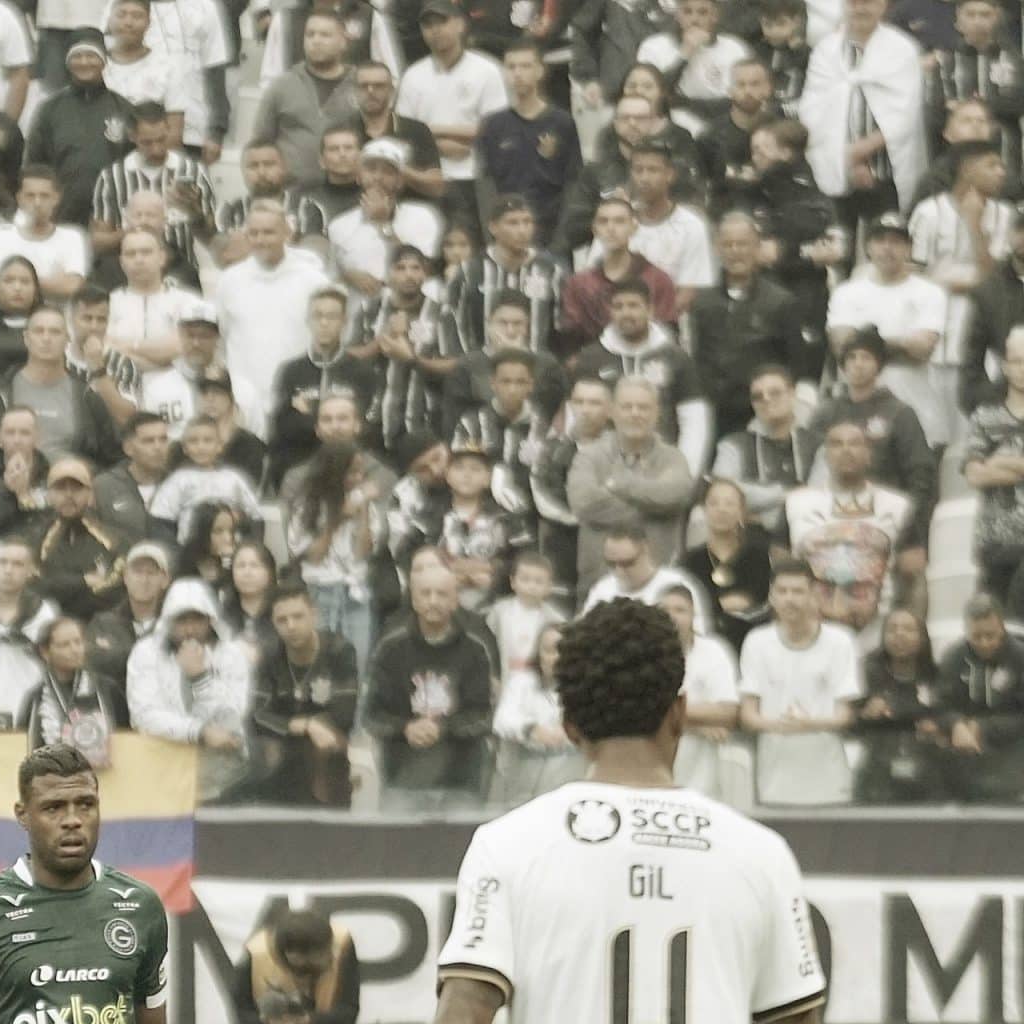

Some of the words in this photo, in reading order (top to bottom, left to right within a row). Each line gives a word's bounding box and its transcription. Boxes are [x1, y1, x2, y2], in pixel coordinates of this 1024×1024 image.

[631, 808, 711, 836] SCCP
[110, 925, 132, 949] G
[55, 967, 111, 983] LARCO
